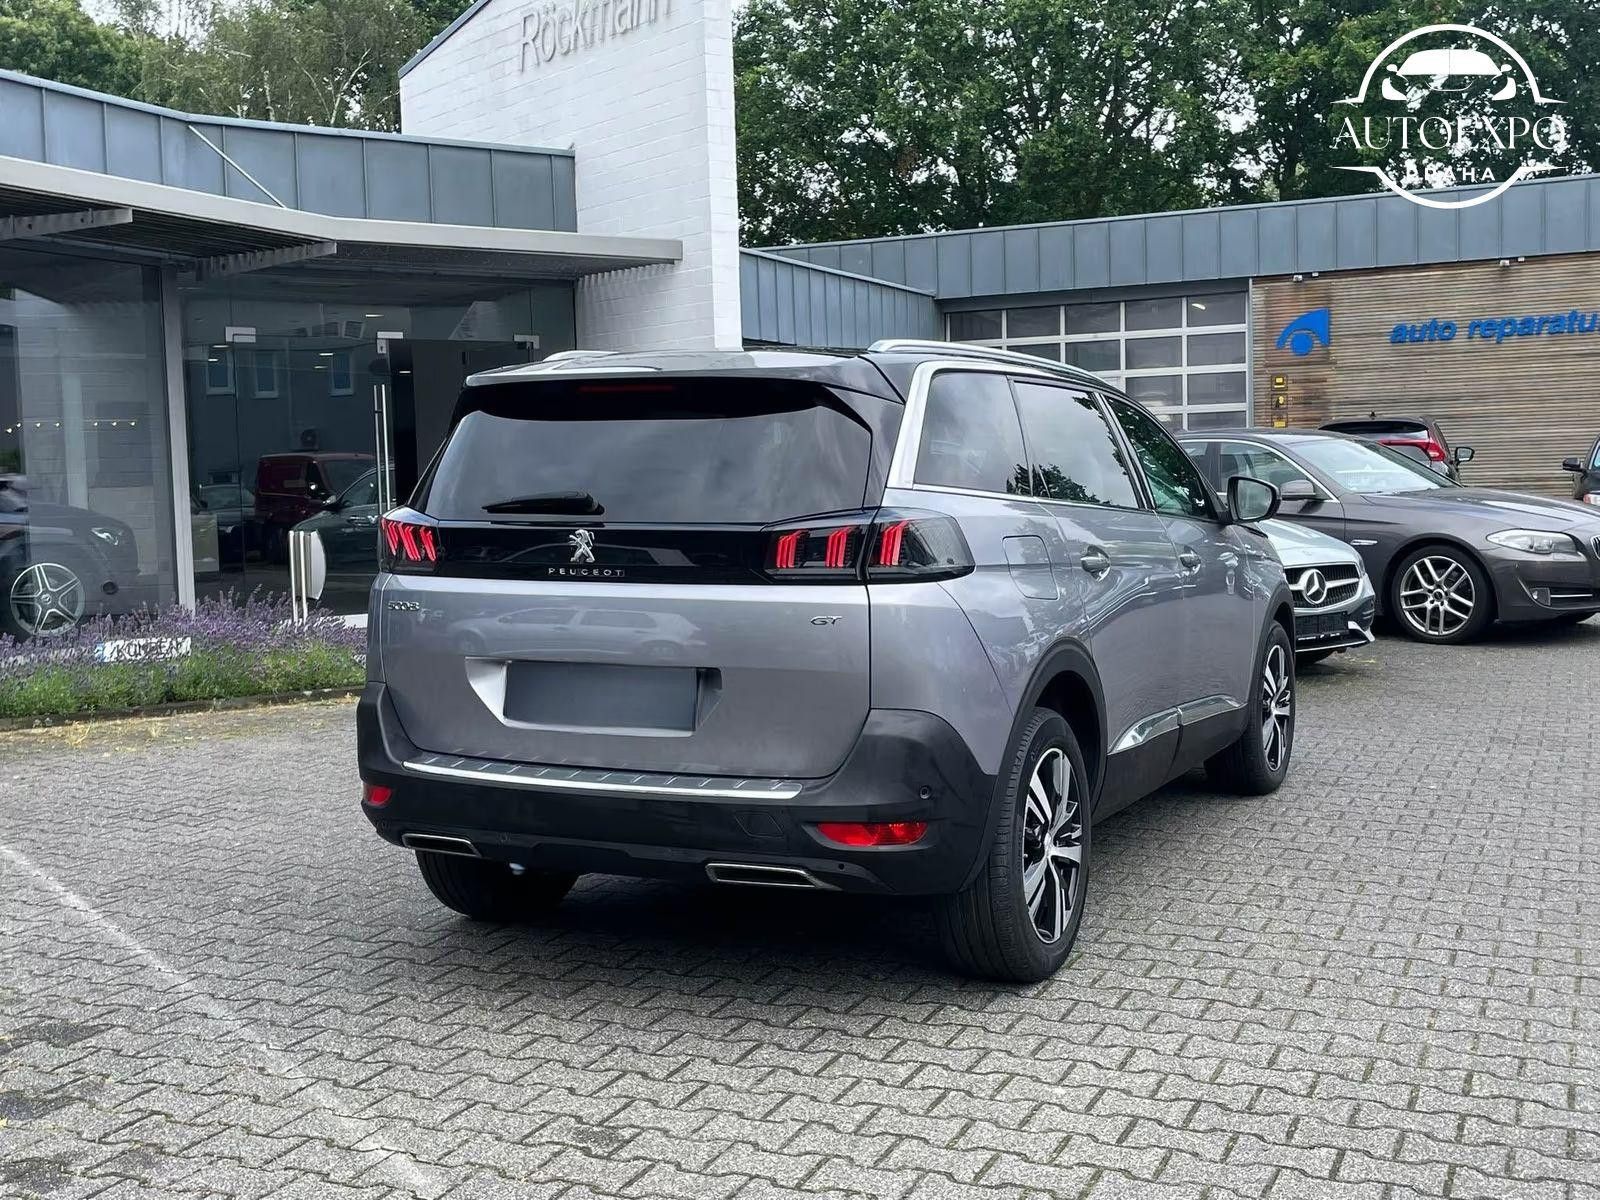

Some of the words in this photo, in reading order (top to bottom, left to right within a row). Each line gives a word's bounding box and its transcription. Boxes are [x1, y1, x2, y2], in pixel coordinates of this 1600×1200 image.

[1390, 319, 1457, 344] auto
[1467, 310, 1600, 343] reparatu
[548, 567, 623, 577] PEUGEOT
[810, 615, 843, 626] GT
